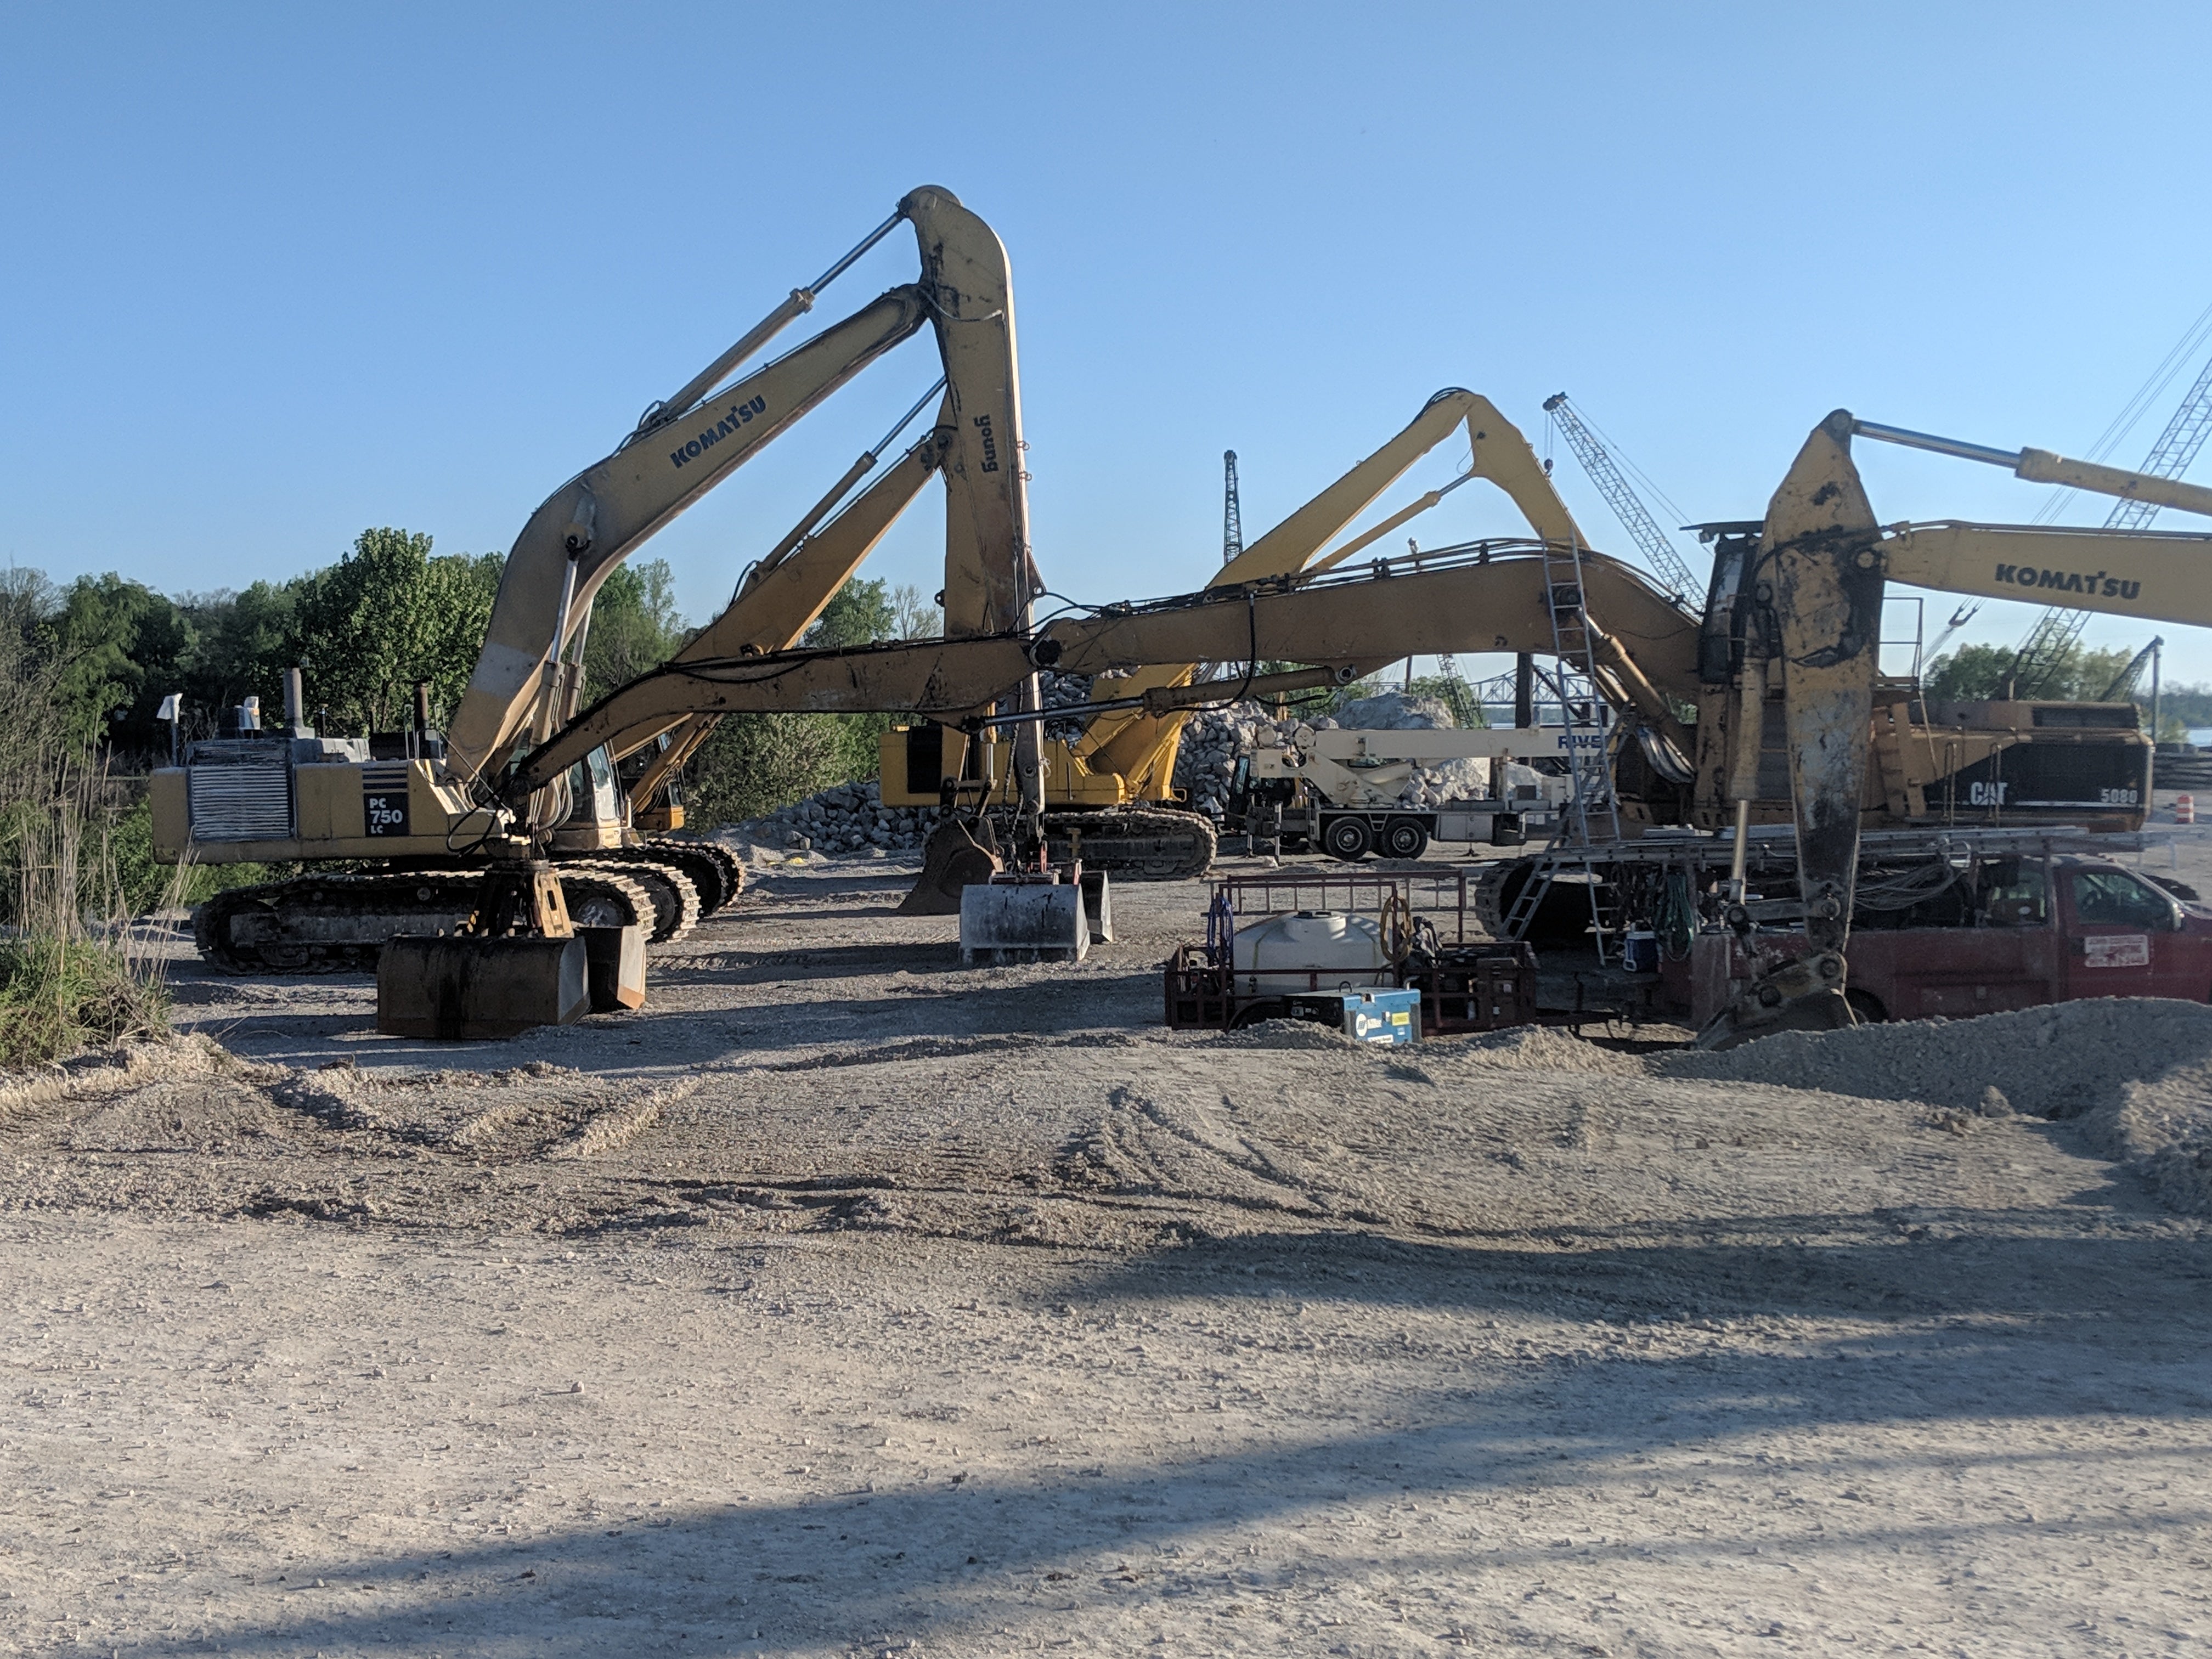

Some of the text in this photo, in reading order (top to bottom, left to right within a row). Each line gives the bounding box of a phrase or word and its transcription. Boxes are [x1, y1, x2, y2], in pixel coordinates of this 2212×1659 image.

[670, 394, 766, 469] KOMATSU
[973, 414, 998, 472] young
[1995, 563, 2141, 600] KOMATSU
[1971, 782, 2008, 805] CAT
[2101, 788, 2138, 804] 5080
[369, 798, 386, 809] PC
[370, 809, 403, 824] 750
[370, 825, 383, 834] LC
